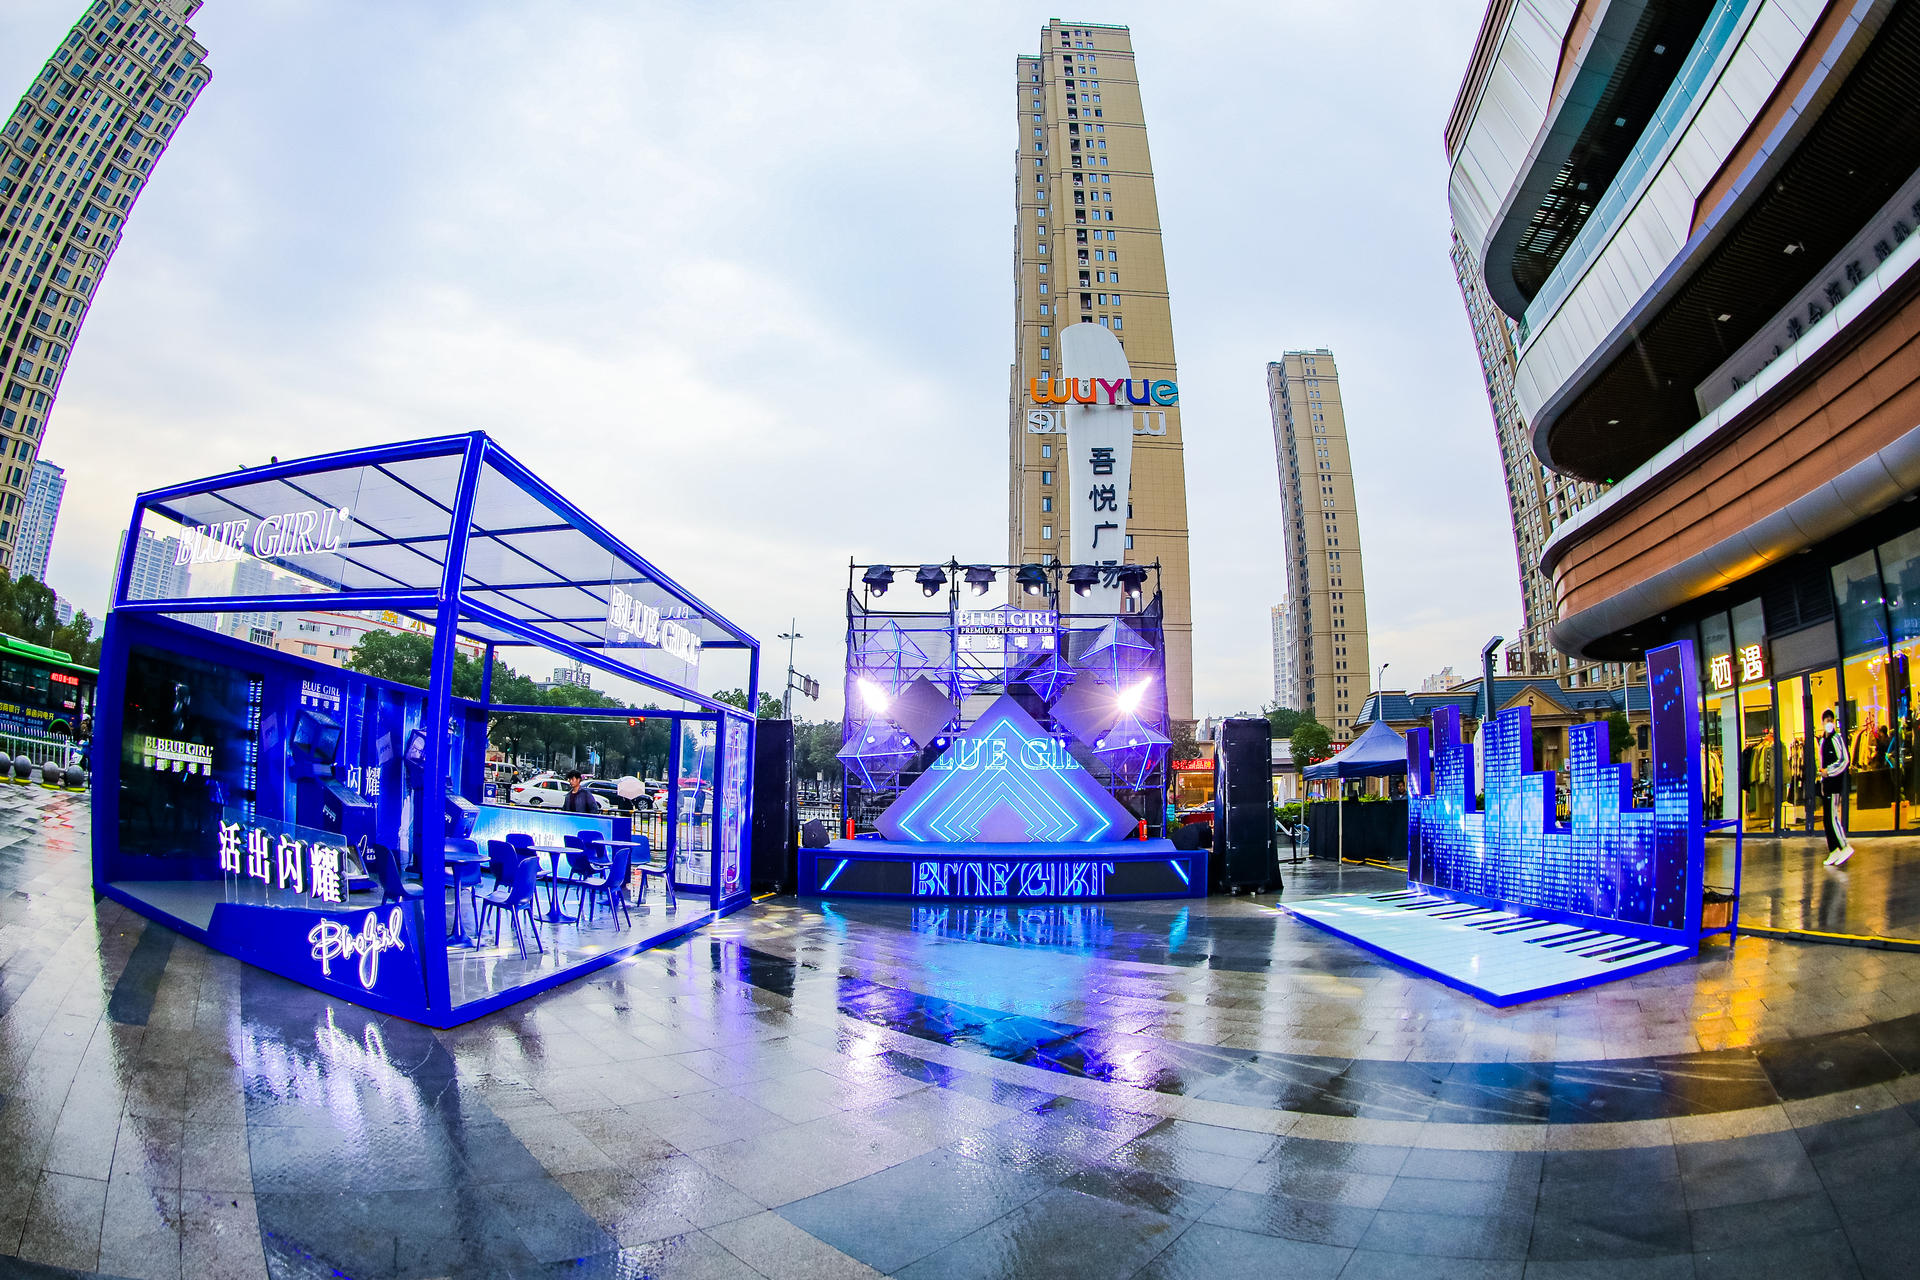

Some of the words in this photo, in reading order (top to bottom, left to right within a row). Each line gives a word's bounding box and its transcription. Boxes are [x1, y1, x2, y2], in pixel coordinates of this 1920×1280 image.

[174, 519, 249, 566] BLUE
[252, 507, 346, 558] GIRL
[610, 585, 660, 646] BLUE
[660, 620, 700, 666] GIRL
[958, 612, 1006, 626] BLUE
[1010, 612, 1056, 626] GIRL
[302, 679, 322, 693] BLUE
[322, 684, 341, 697] GIRL
[1710, 645, 1764, 690] 栖遇
[218, 820, 344, 903] 活出闪耀
